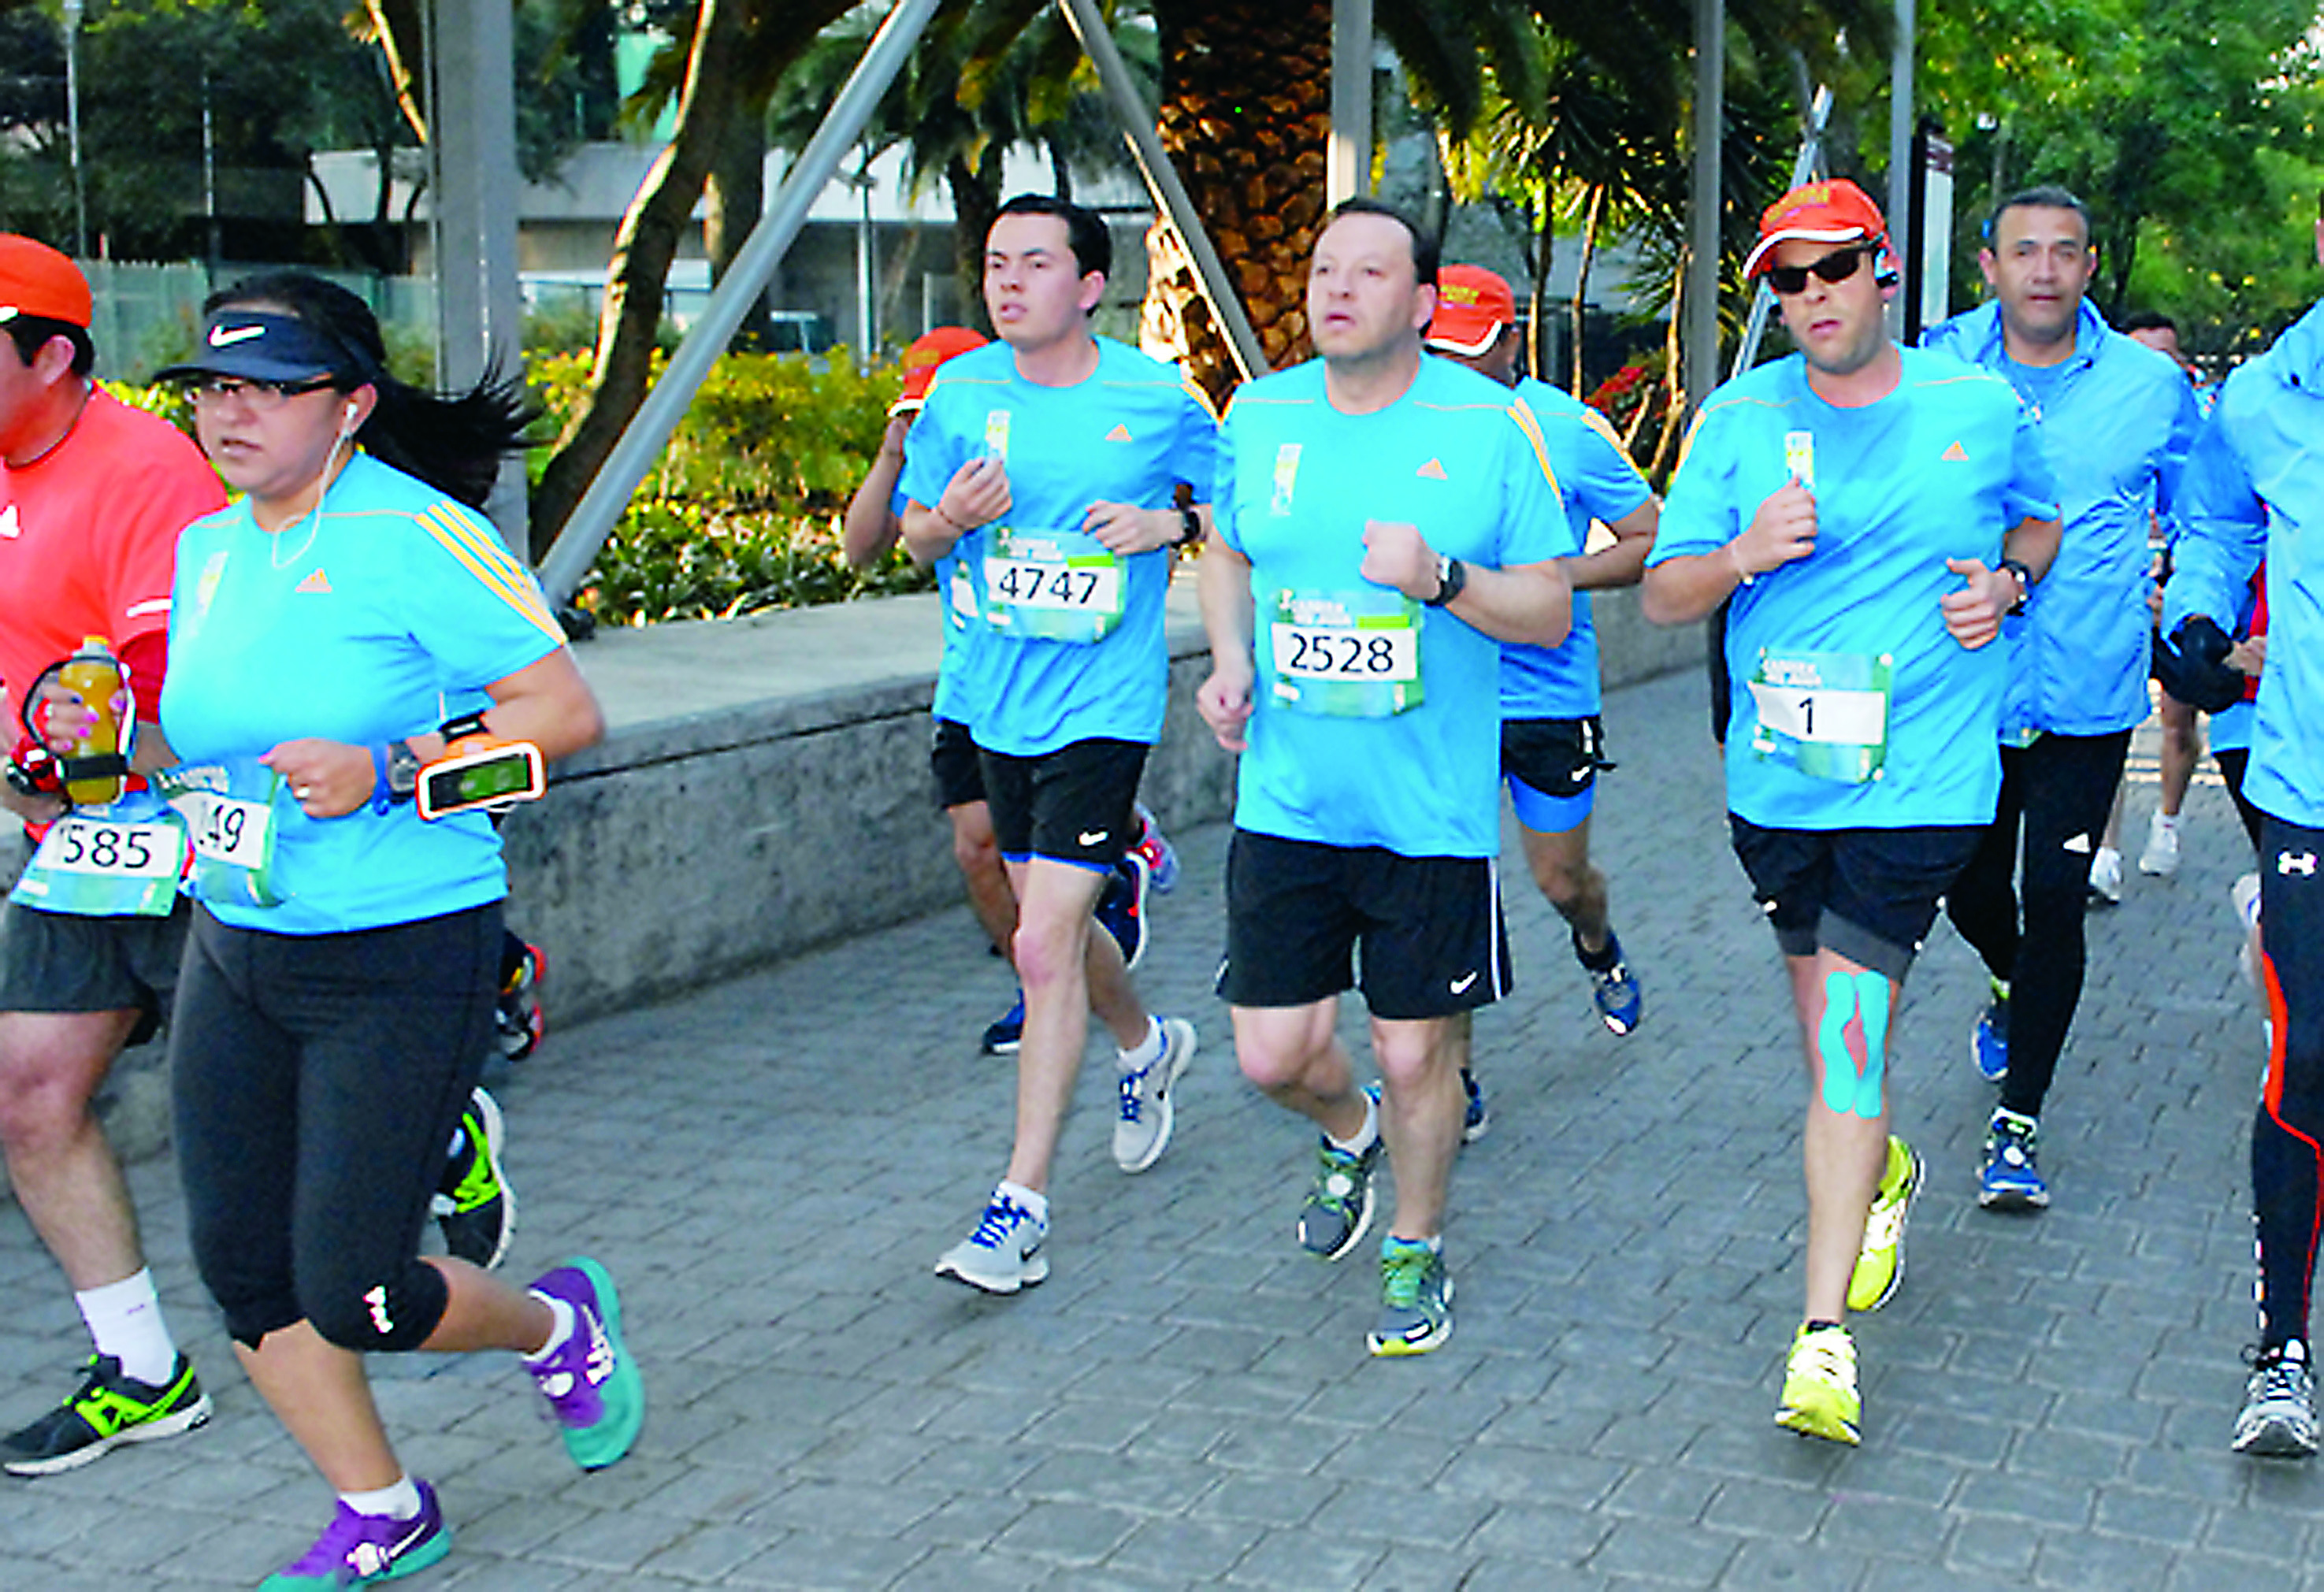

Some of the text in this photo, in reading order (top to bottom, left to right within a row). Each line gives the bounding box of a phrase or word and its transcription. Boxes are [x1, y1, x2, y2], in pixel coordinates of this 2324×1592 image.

[999, 567, 1098, 604] 4747
[1290, 633, 1394, 673] 2528
[1799, 697, 1813, 735] 1
